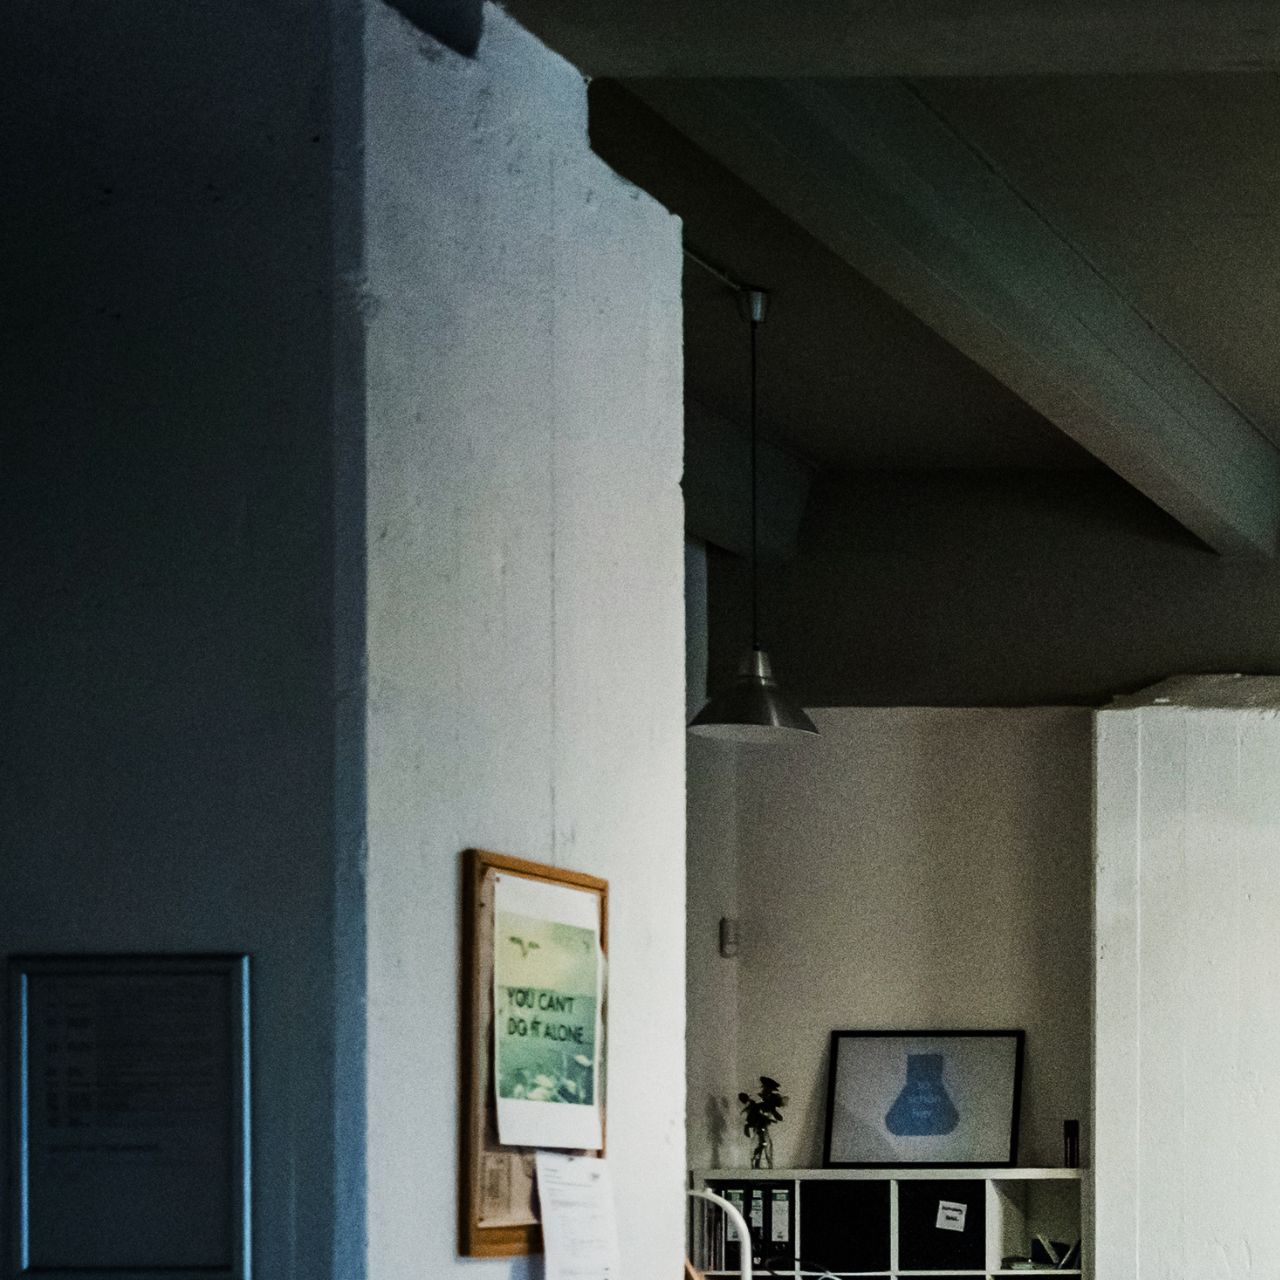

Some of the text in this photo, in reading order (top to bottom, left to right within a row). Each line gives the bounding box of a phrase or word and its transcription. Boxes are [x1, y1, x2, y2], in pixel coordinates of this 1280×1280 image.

[507, 988, 534, 1008] YOU
[508, 1018, 527, 1036] DO
[544, 1023, 583, 1044] ALONE
